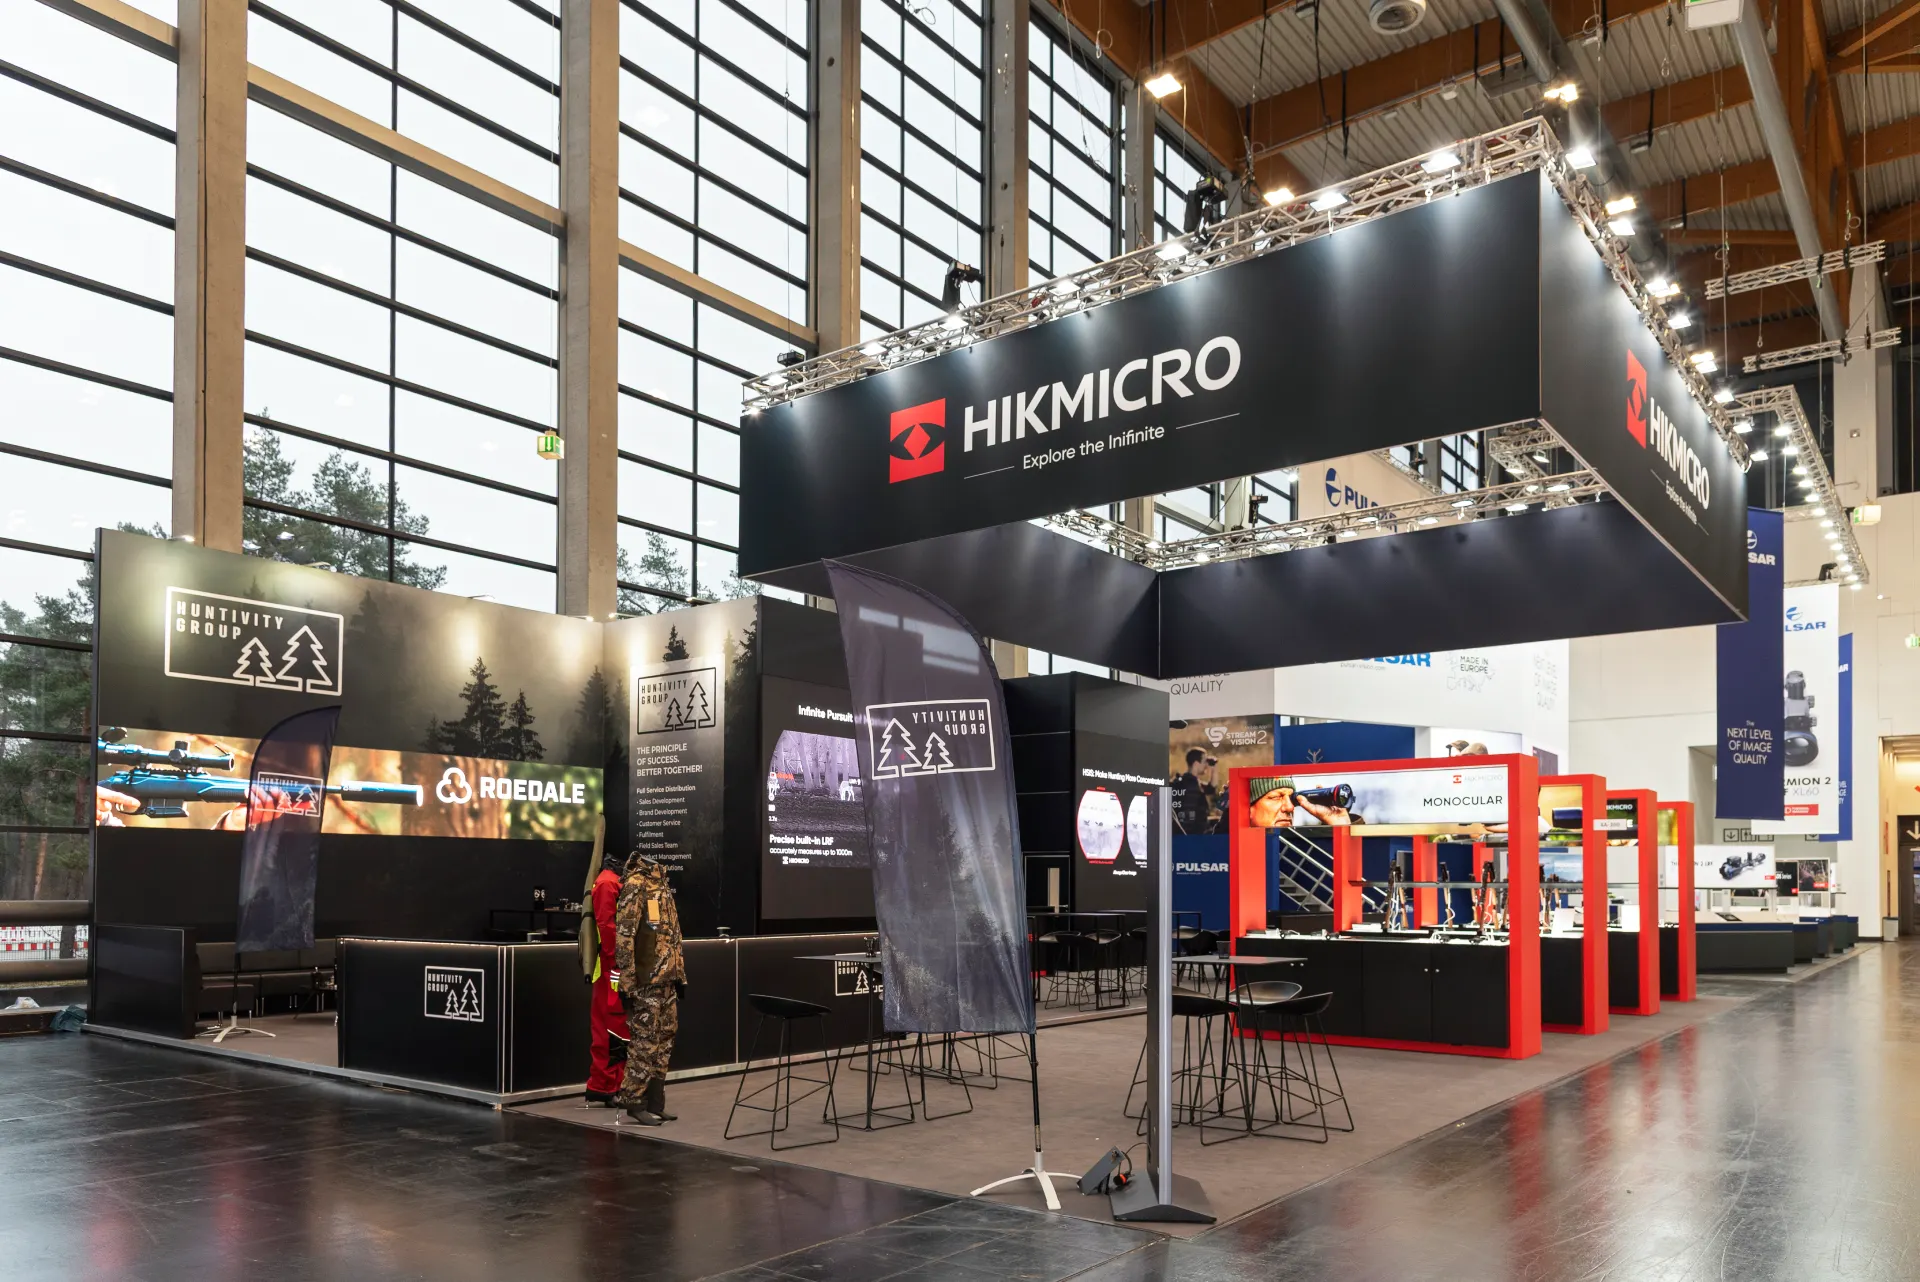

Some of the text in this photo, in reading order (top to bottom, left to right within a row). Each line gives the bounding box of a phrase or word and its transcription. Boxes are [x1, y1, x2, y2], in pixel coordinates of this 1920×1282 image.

[964, 336, 1241, 452] HIKMICRO
[1023, 426, 1165, 469] Explore the Inifinite
[1650, 397, 1710, 510] HIKMICRO
[1748, 552, 1775, 565] SAR
[177, 601, 284, 629] HUNTIVITY
[177, 618, 241, 639] GROUP
[1785, 621, 1826, 632] LSAR
[1460, 656, 1480, 664] MADE
[1460, 664, 1488, 674] EUROPE
[641, 679, 688, 693] HUNTIVITY
[1170, 680, 1224, 695] QUALITY
[641, 693, 669, 705] GROUP
[798, 705, 825, 718] Infinite
[827, 709, 853, 722] Pursuit
[1226, 731, 1256, 739] STREAM
[1257, 730, 1267, 744] 2
[1727, 728, 1773, 740] NEXT LEVEL
[637, 743, 688, 754] THE PRINCIPLE
[1729, 740, 1772, 753] OF IMAGE
[647, 755, 679, 765] SUCCESS.
[1733, 753, 1767, 764] QUALITY
[637, 764, 703, 776] BETTER TOGETHER!
[1785, 777, 1831, 786] MION 2
[480, 776, 585, 804] ROEDALE
[647, 785, 664, 793] Service
[665, 784, 696, 792] Distribution
[652, 797, 685, 805] Development
[1423, 796, 1503, 807] MONOCULAR
[654, 808, 687, 816] Development
[770, 834, 833, 845] Precise built-in LRF
[769, 847, 797, 855] accurately
[1176, 863, 1229, 872] PULSAR
[427, 973, 463, 983] HUNTIVITY
[427, 983, 448, 992] GROUP
